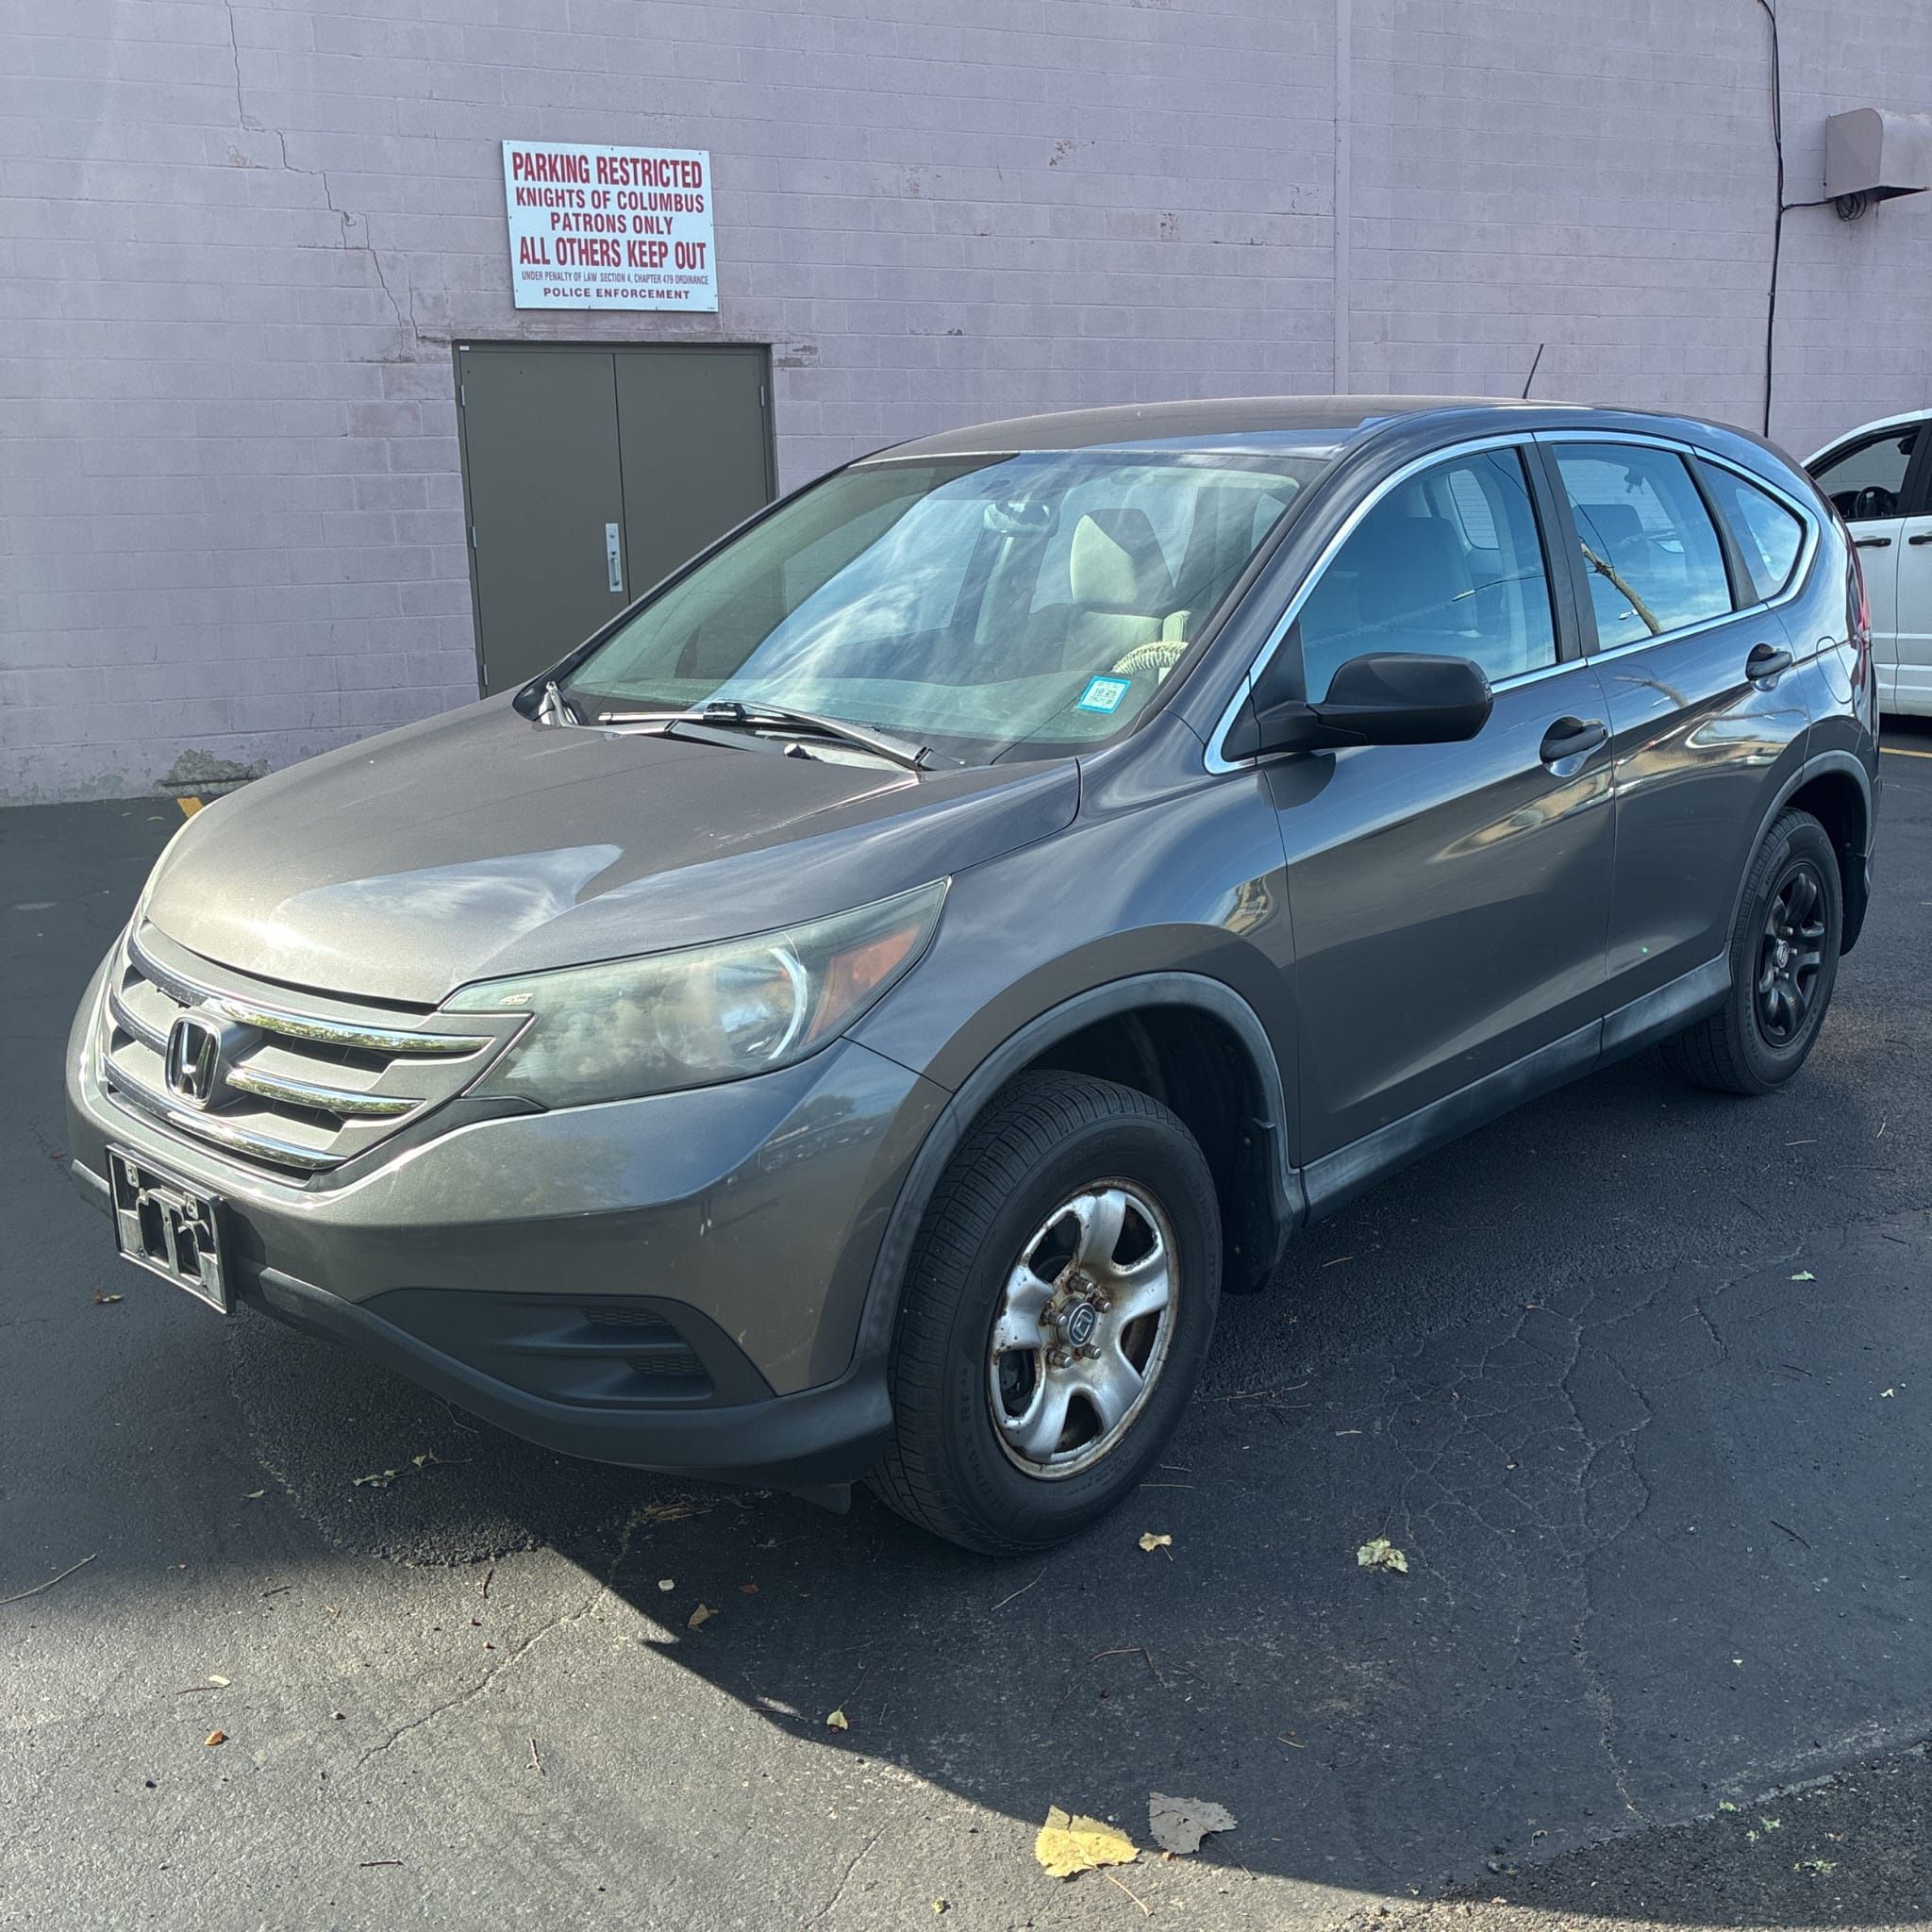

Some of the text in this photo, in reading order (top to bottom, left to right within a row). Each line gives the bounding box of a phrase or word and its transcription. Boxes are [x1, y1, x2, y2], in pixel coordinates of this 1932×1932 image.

[512, 151, 703, 189] PARKING RESTRICTED
[516, 187, 705, 213] KNIGHTS OF COLUMBUS
[550, 211, 674, 235] PATRONS ONLY
[520, 236, 706, 270] ALL OTHERS KEEP OUT
[521, 271, 543, 281] UNDER
[544, 271, 572, 282] PENALTY
[574, 272, 582, 282] OF
[583, 272, 597, 282] LAW
[600, 272, 625, 283] SECTION
[634, 273, 661, 284] CHAPTER
[675, 275, 709, 286] ORDINANCE
[543, 287, 690, 300] POLICE ENFORCEMENT
